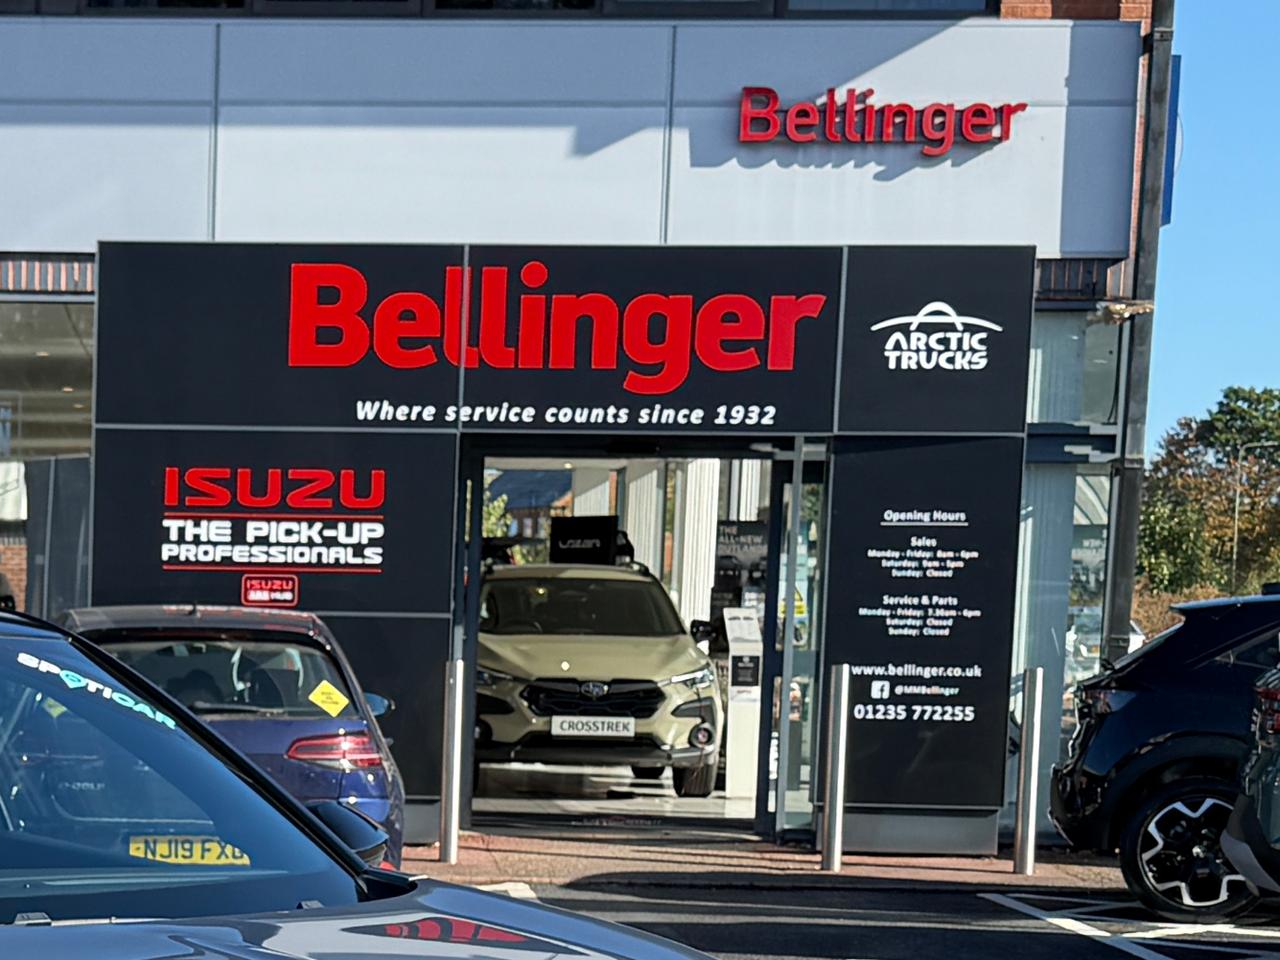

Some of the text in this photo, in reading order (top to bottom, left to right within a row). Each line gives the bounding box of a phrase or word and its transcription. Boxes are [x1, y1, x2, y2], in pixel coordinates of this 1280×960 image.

[738, 86, 1028, 158] Bellinger
[287, 260, 827, 395] Bellinger
[884, 331, 988, 351] ARCTIC
[884, 351, 988, 370] TRUCKS
[356, 400, 777, 426] Where service counts since 1932
[164, 467, 385, 509] ISUZU
[883, 510, 967, 522] Opening Hours
[162, 519, 386, 545] THE PICK-UP
[910, 536, 937, 547] Sales
[161, 543, 384, 565] PROFESSIONALS
[867, 549, 900, 558] Monday
[926, 569, 953, 577] Closed
[246, 579, 294, 591] ISUZU
[882, 595, 958, 606] Service & Parts
[858, 608, 891, 617] Monday
[926, 618, 953, 626] Closed
[923, 627, 950, 636] Closed
[851, 664, 982, 679] www.bellinger.co.uk
[854, 704, 975, 721] 01235 772255
[559, 719, 631, 732] CROSSTREK
[144, 839, 193, 859] NJ19
